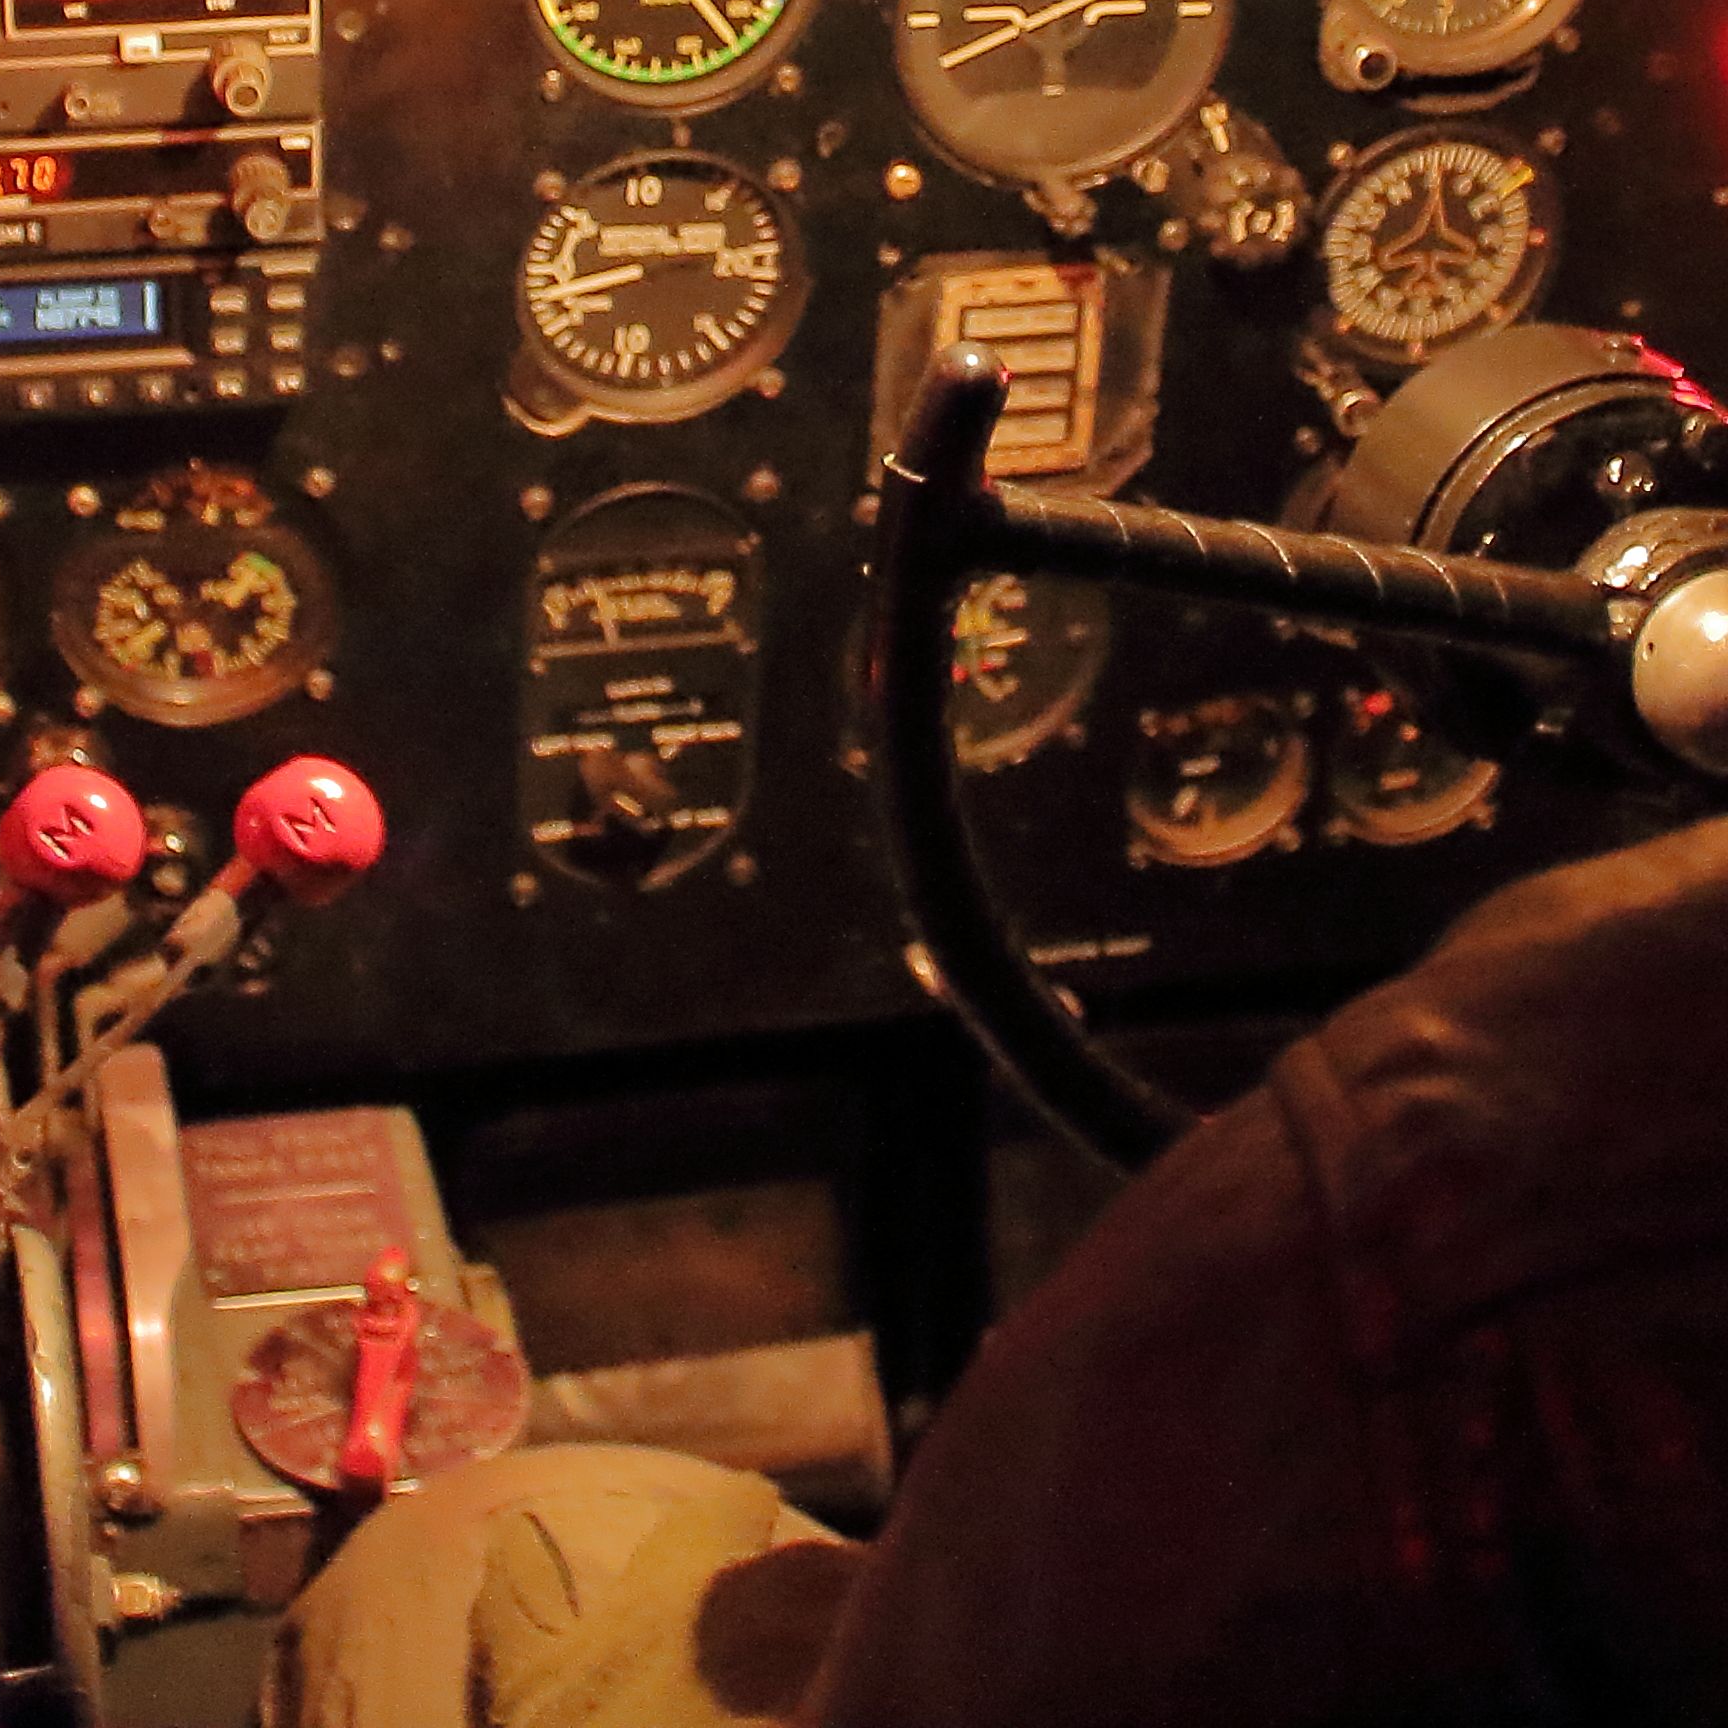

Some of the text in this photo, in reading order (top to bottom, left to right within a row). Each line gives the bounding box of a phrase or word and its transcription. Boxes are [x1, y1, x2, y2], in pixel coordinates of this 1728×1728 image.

[625, 176, 663, 207] 10
[615, 324, 651, 355] 10
[39, 804, 94, 862] M
[280, 797, 337, 853] M
